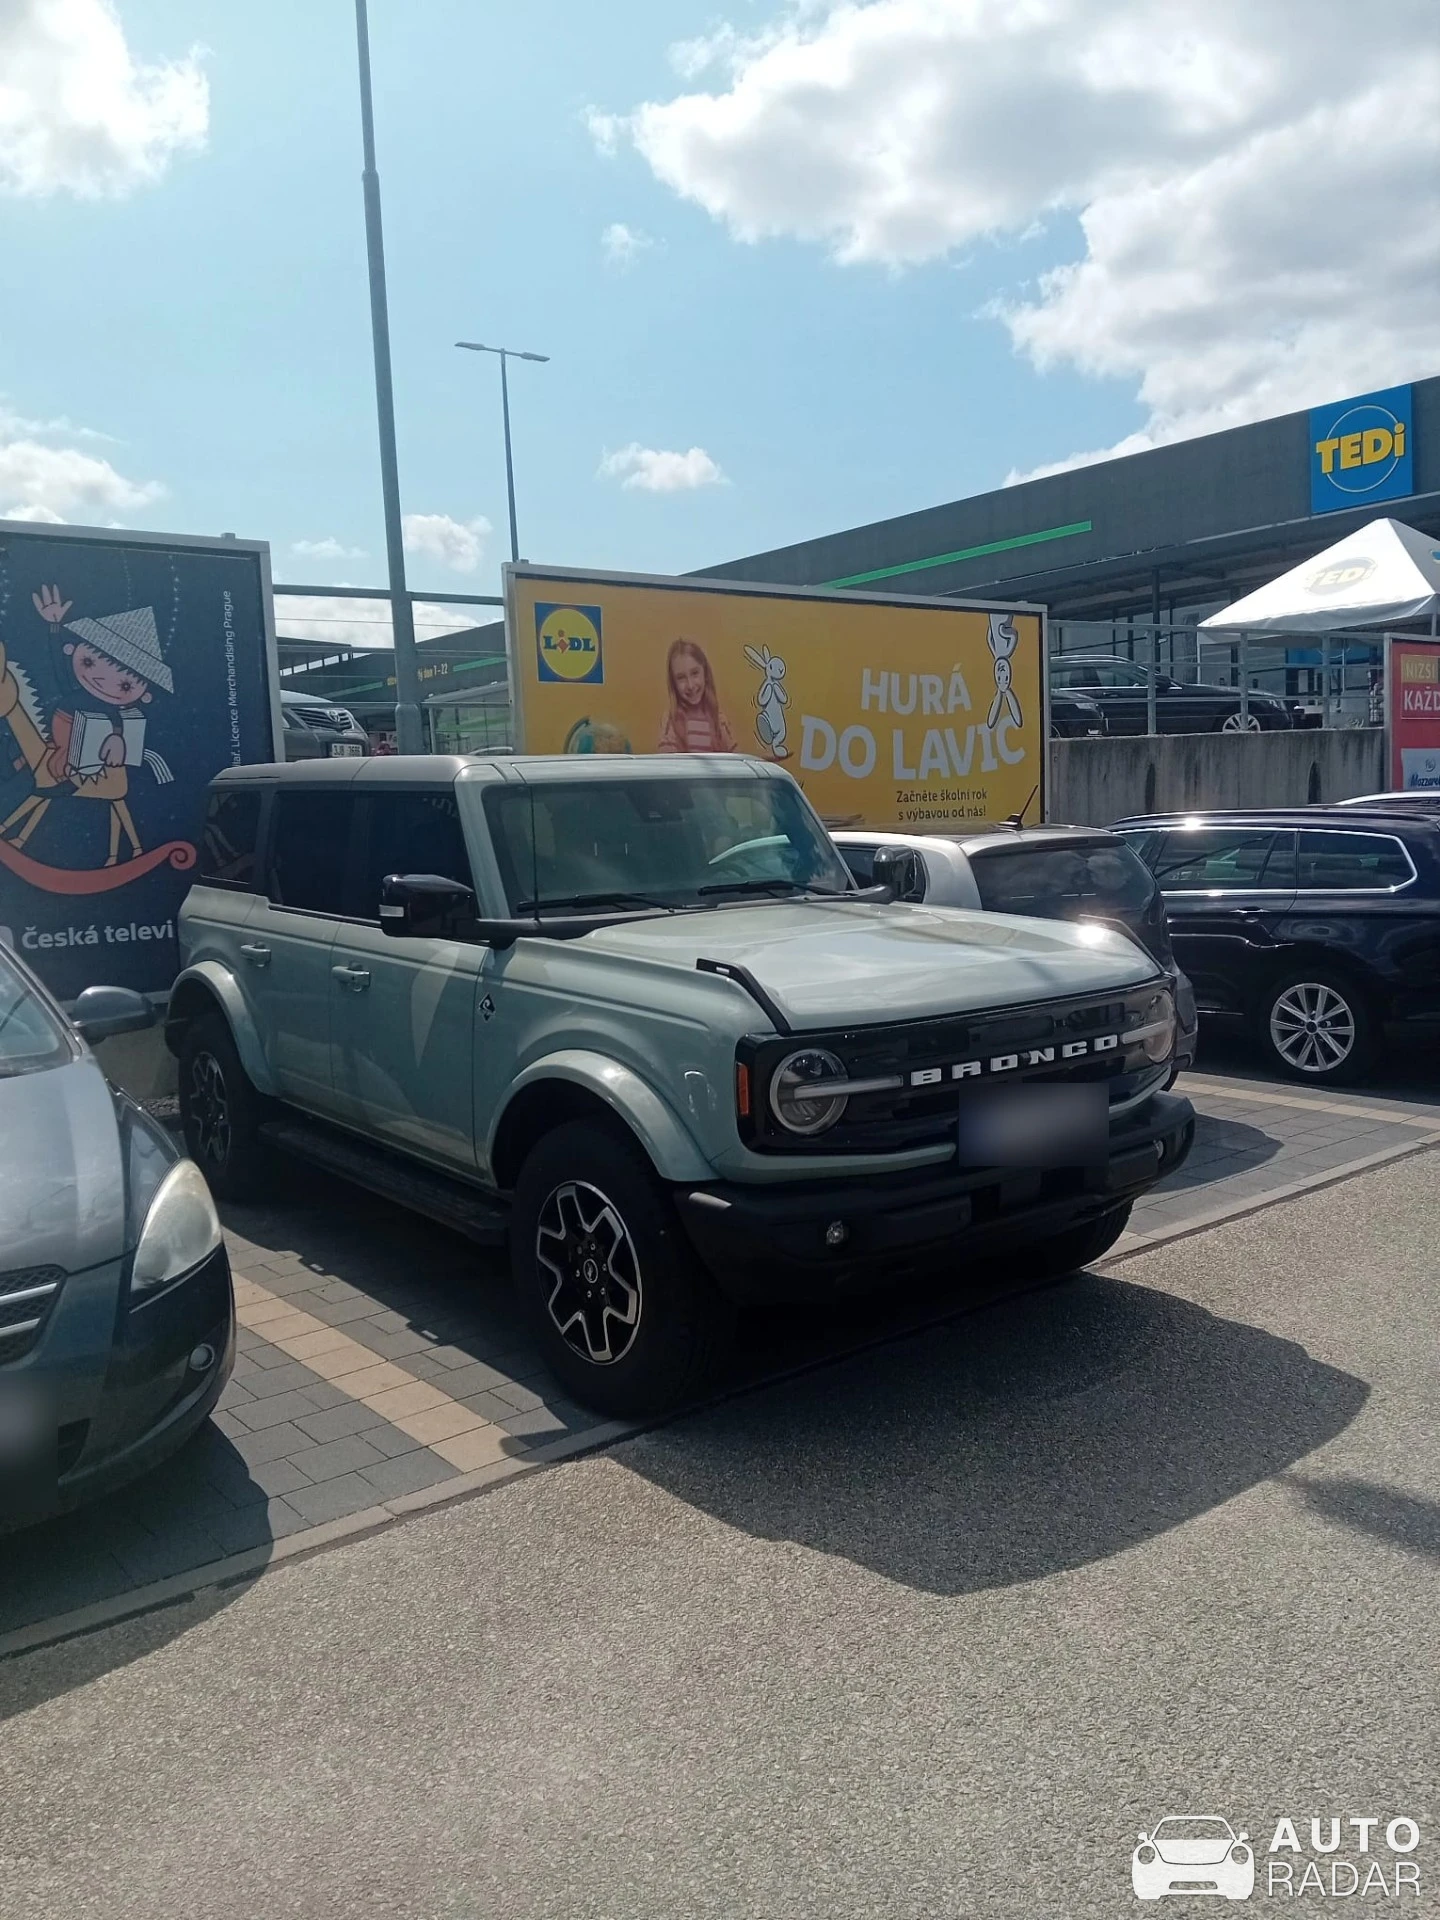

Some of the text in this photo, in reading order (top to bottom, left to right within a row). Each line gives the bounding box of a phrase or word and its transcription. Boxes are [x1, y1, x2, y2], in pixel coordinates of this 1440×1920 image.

[1315, 423, 1405, 474] TEDi
[222, 590, 233, 629] Prague
[225, 630, 238, 707] Merchandising
[861, 663, 972, 715] HURÁ
[230, 709, 240, 747] Licence
[800, 715, 1025, 781] DO LAVIC
[896, 788, 987, 803] Začněte školní rok
[898, 805, 986, 822] s výbavou od nás!
[21, 919, 174, 950] Česká televi
[910, 1034, 1119, 1087] BRONCO
